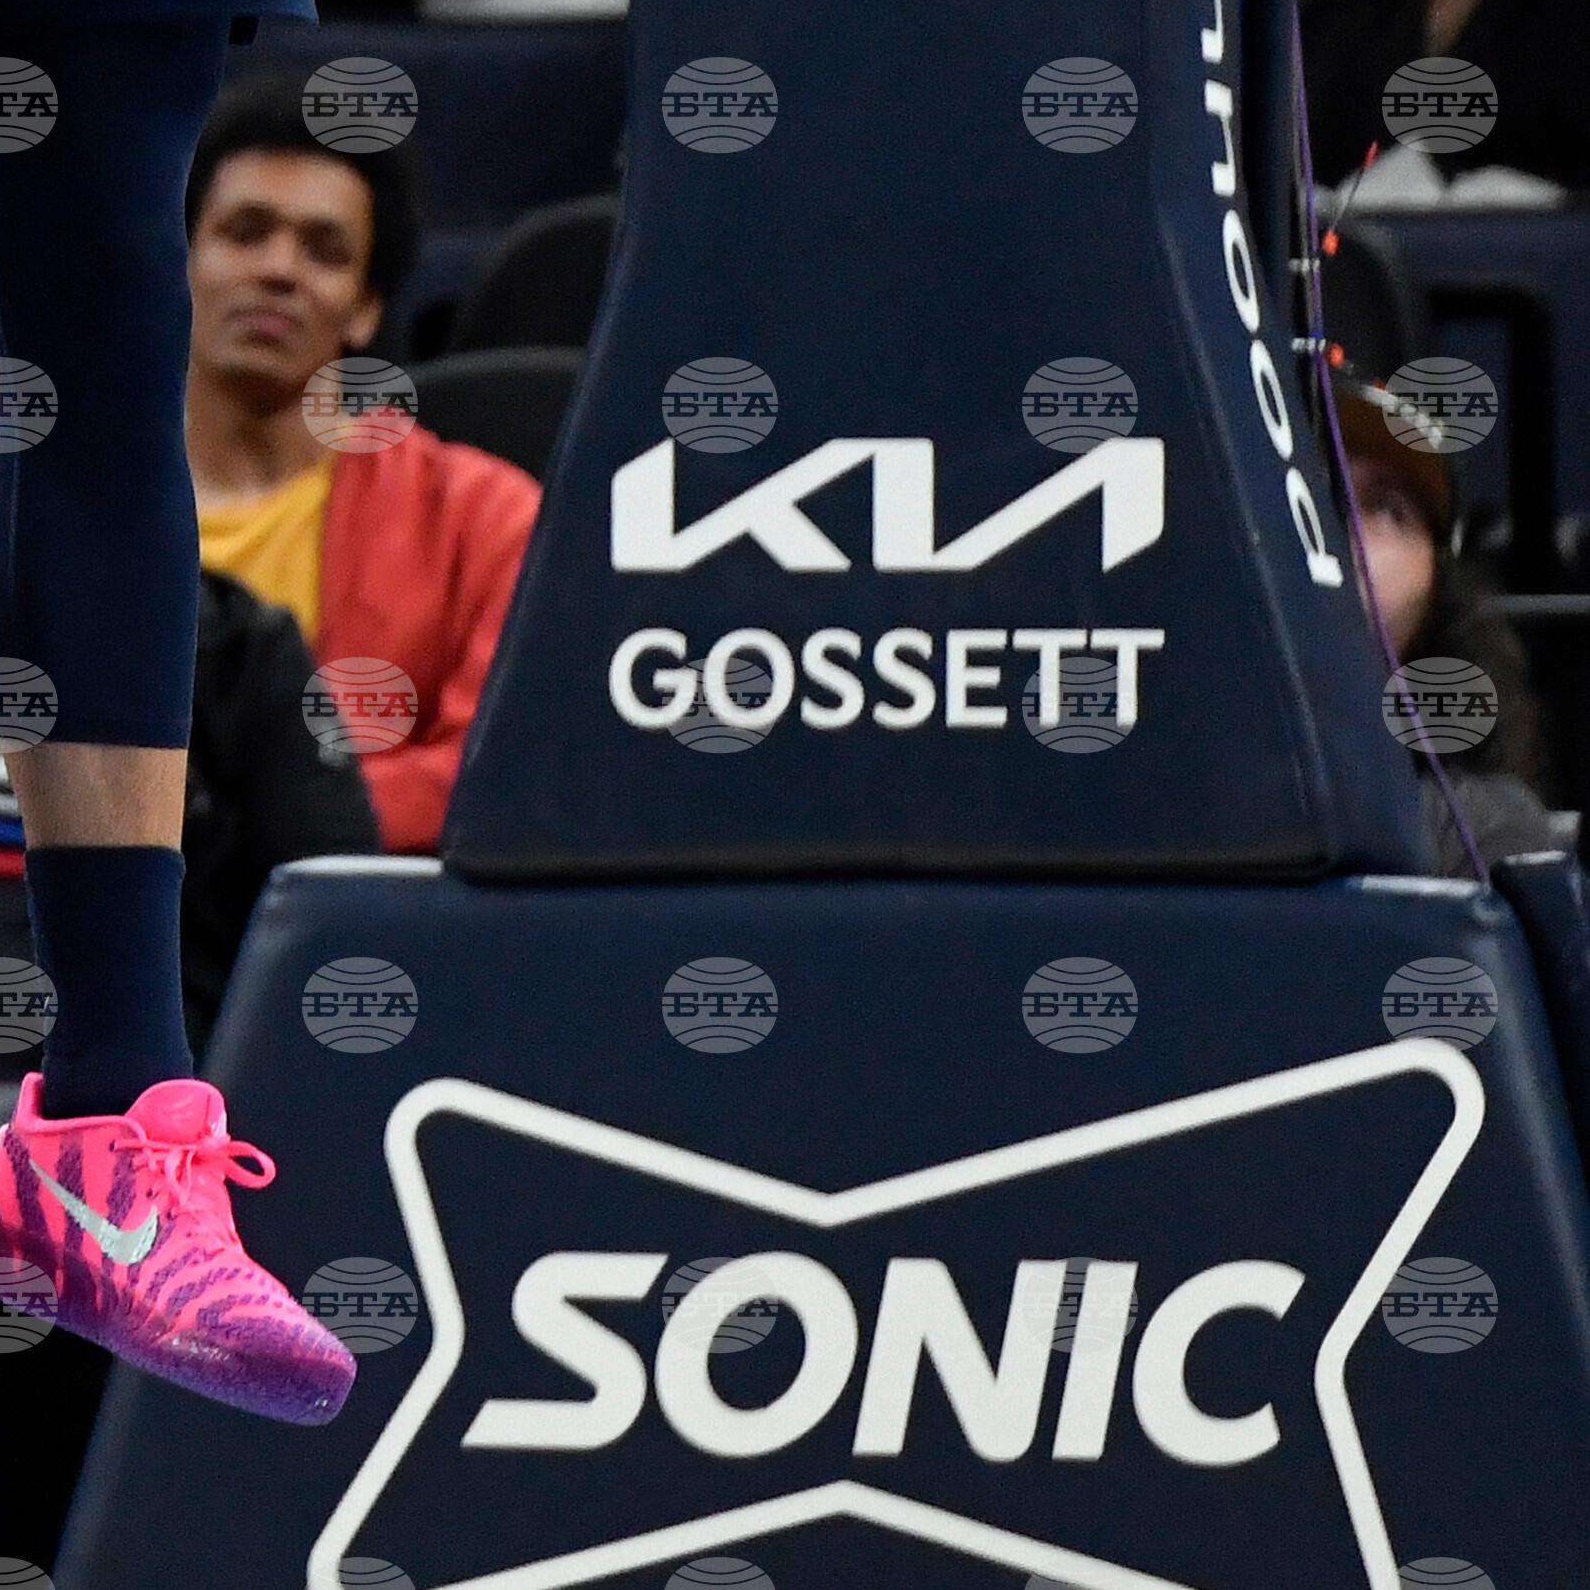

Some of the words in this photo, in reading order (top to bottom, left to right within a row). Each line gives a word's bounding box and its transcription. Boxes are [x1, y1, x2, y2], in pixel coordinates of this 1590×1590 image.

[610, 436, 1165, 574] KIA
[608, 626, 1166, 730] GOSSETT
[460, 1249, 1308, 1467] SONIC
